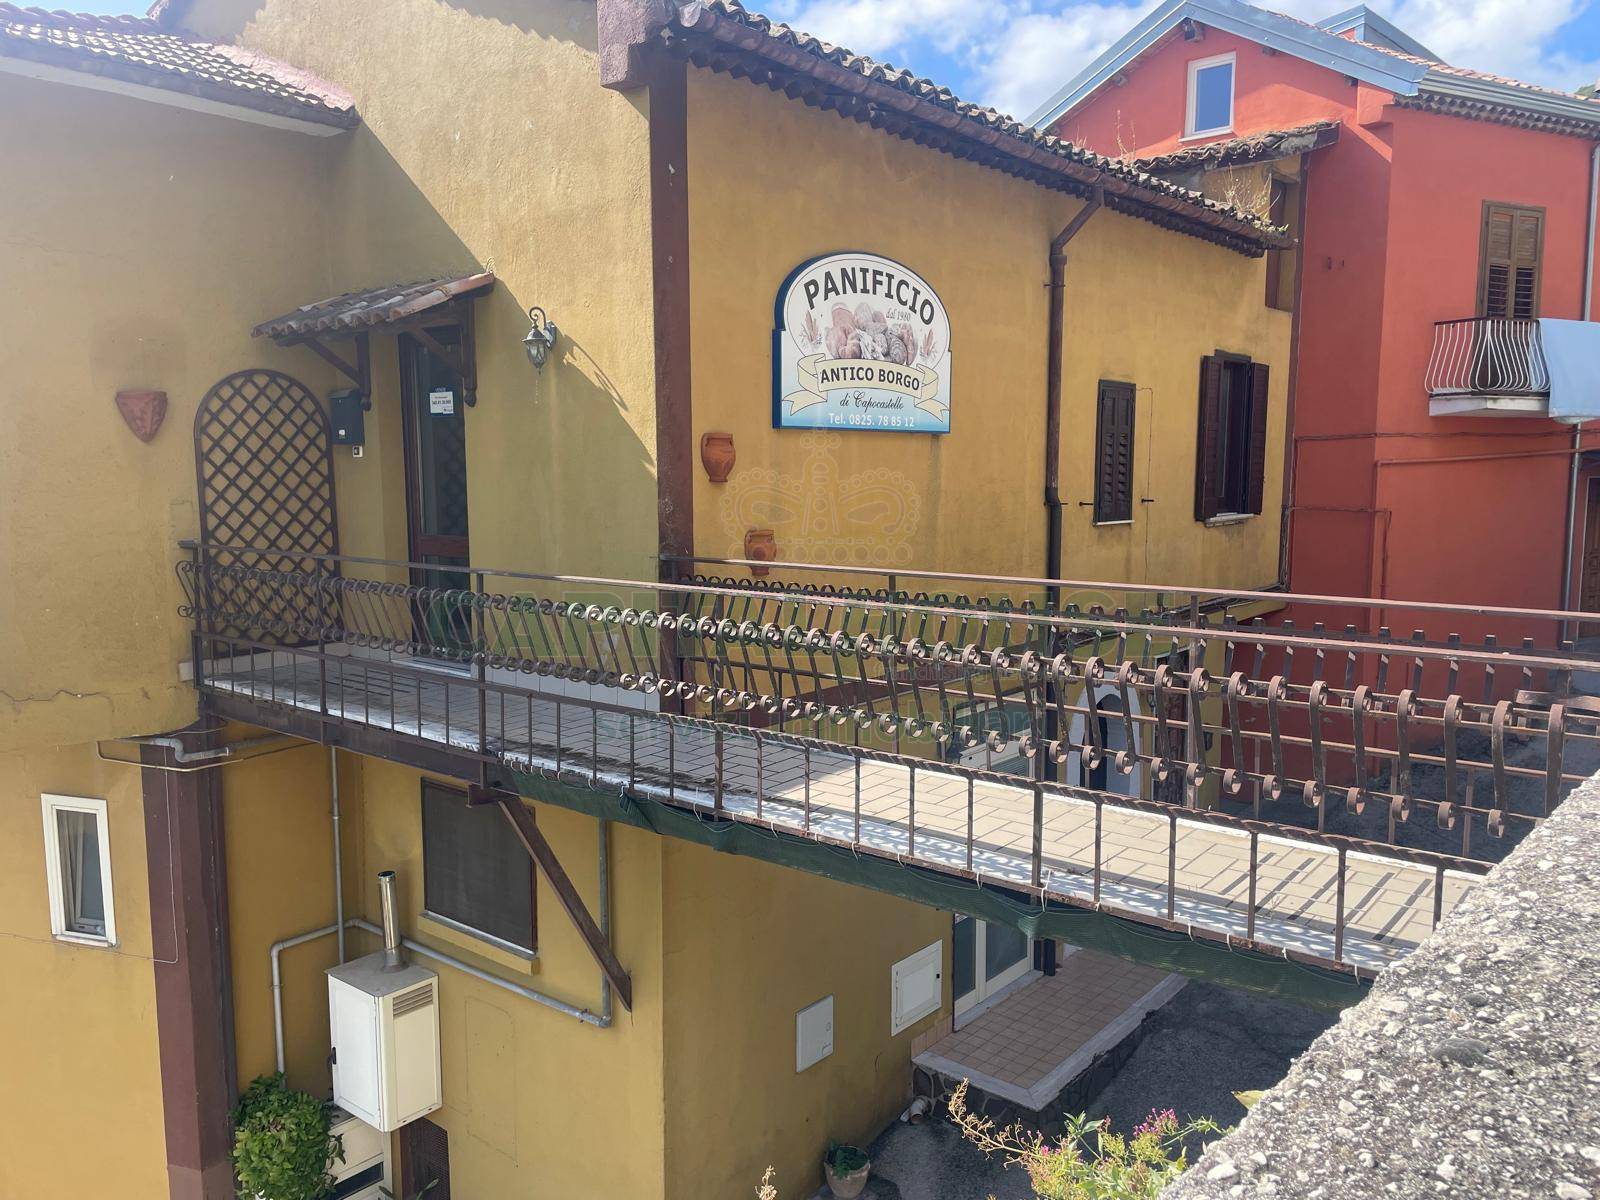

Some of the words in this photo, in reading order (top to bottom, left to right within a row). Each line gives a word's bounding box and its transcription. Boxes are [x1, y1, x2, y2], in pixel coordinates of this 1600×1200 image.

[803, 267, 935, 326] PANIFICIO
[821, 366, 874, 384] ANTICO
[878, 368, 920, 391] BORGO
[840, 392, 851, 407] di
[853, 390, 904, 413] Capocastello
[828, 413, 846, 425] Tel.
[849, 414, 875, 426] 0825.
[878, 416, 889, 426] 78
[891, 417, 901, 427] 85
[905, 417, 915, 427] 12
